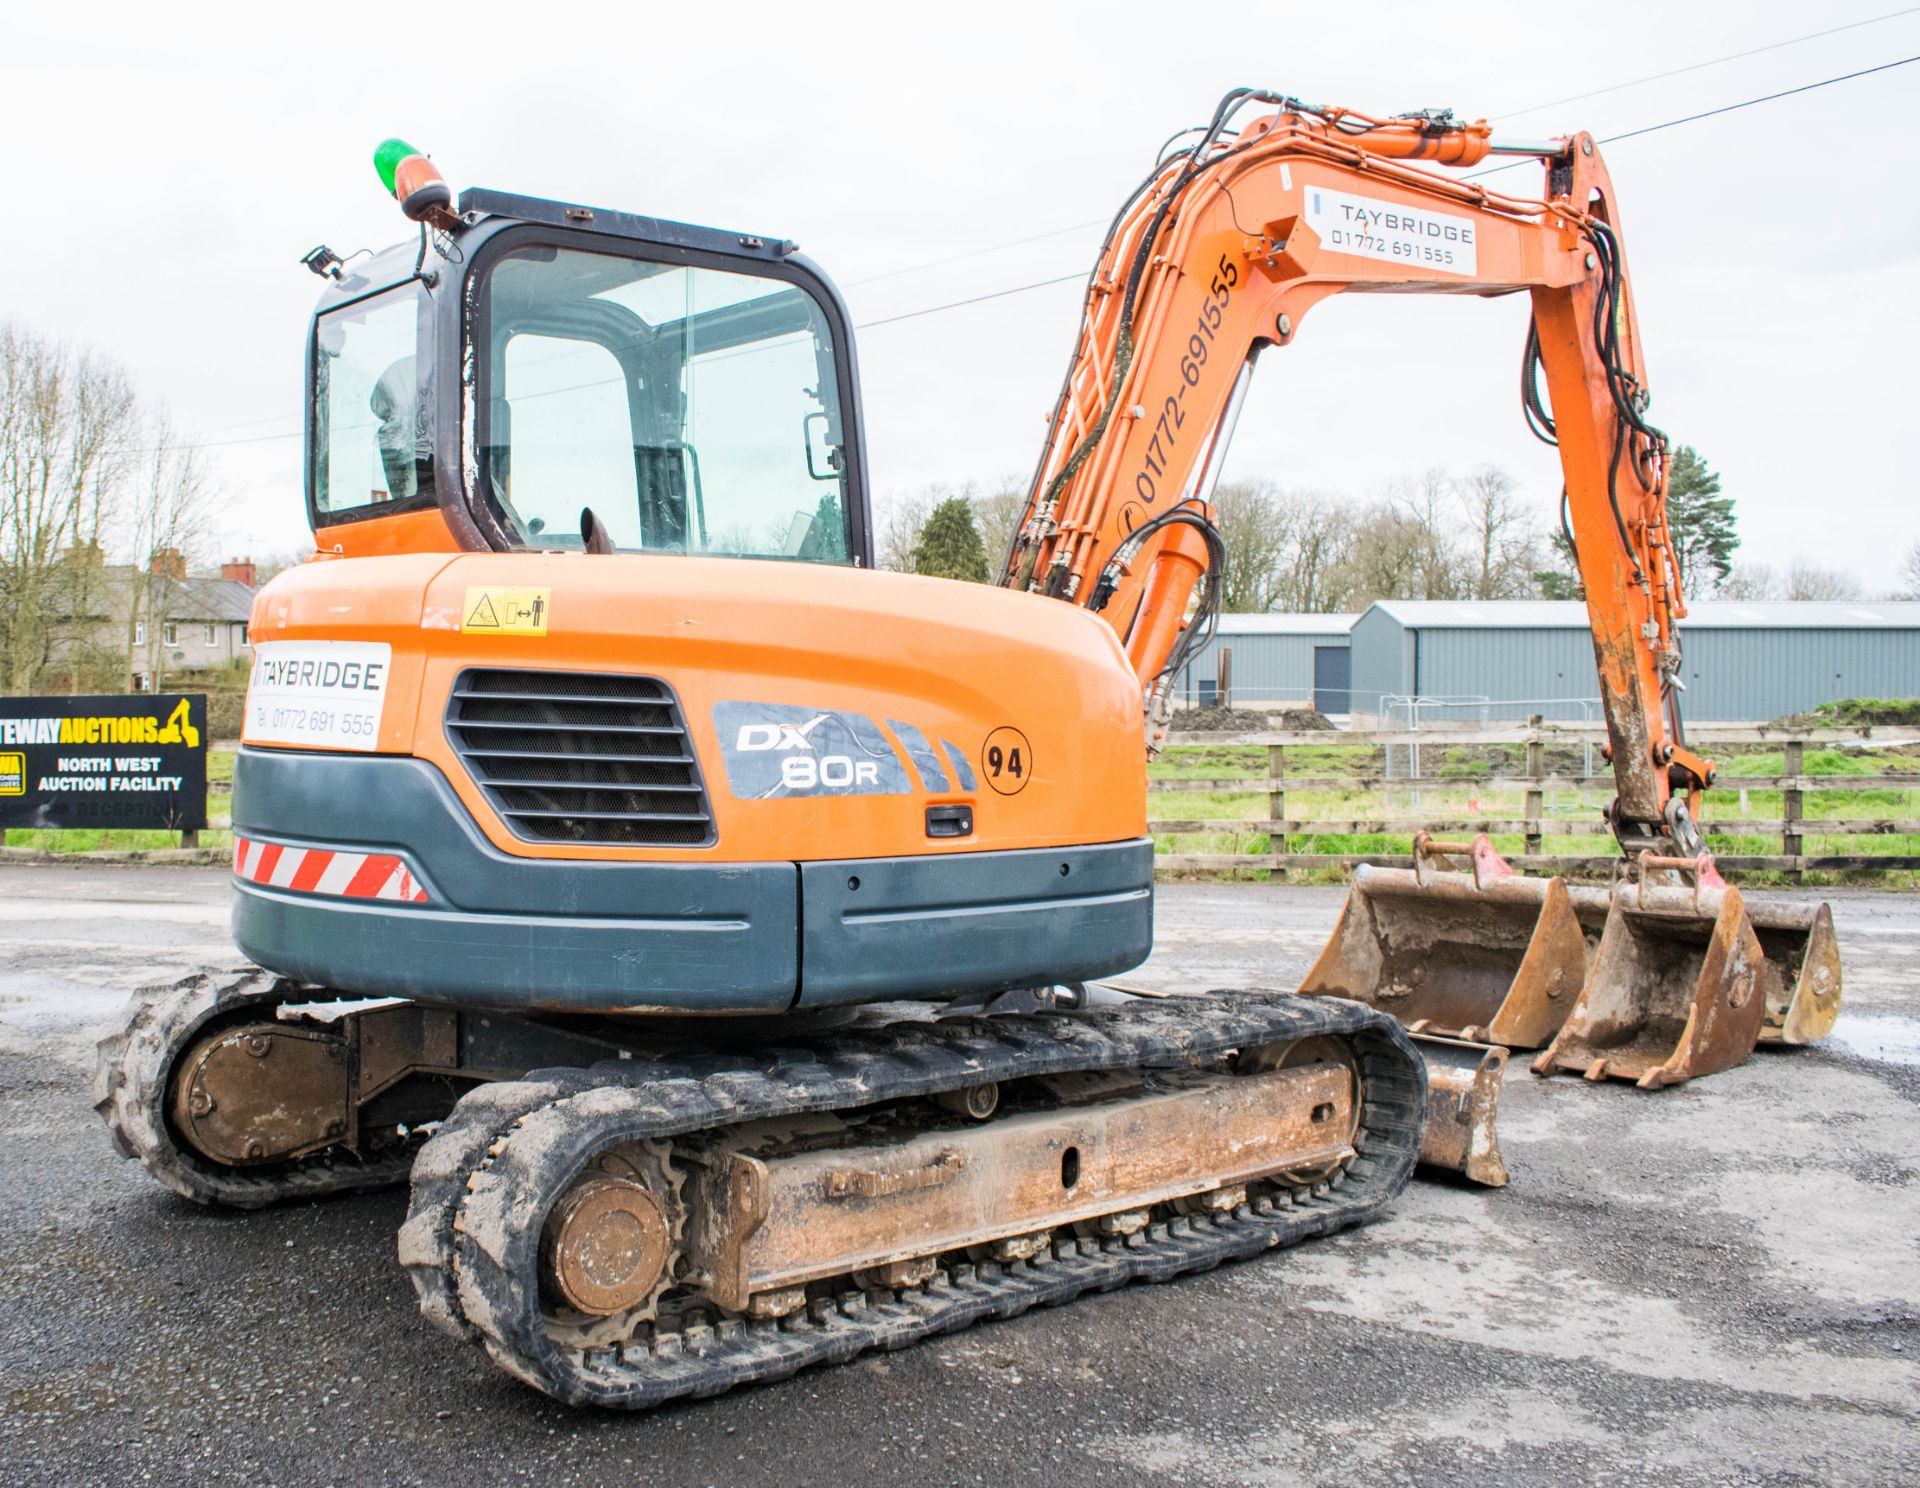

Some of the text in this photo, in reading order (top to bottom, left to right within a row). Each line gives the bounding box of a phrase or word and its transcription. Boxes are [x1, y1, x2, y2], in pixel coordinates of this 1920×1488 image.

[1341, 204, 1473, 244] TAYBRIDGE
[1332, 230, 1454, 264] 01772 691555
[1136, 254, 1238, 504] 01772-691555
[263, 660, 383, 691] TAYBRIDGE
[272, 708, 305, 730] 01772
[310, 709, 335, 732] 691
[341, 712, 375, 736] 555
[736, 714, 831, 752] DX
[58, 757, 162, 772] NORTH WEST
[781, 756, 879, 789] 80R
[988, 745, 1023, 780] 94
[38, 777, 182, 791] AUCTION FACILITY
